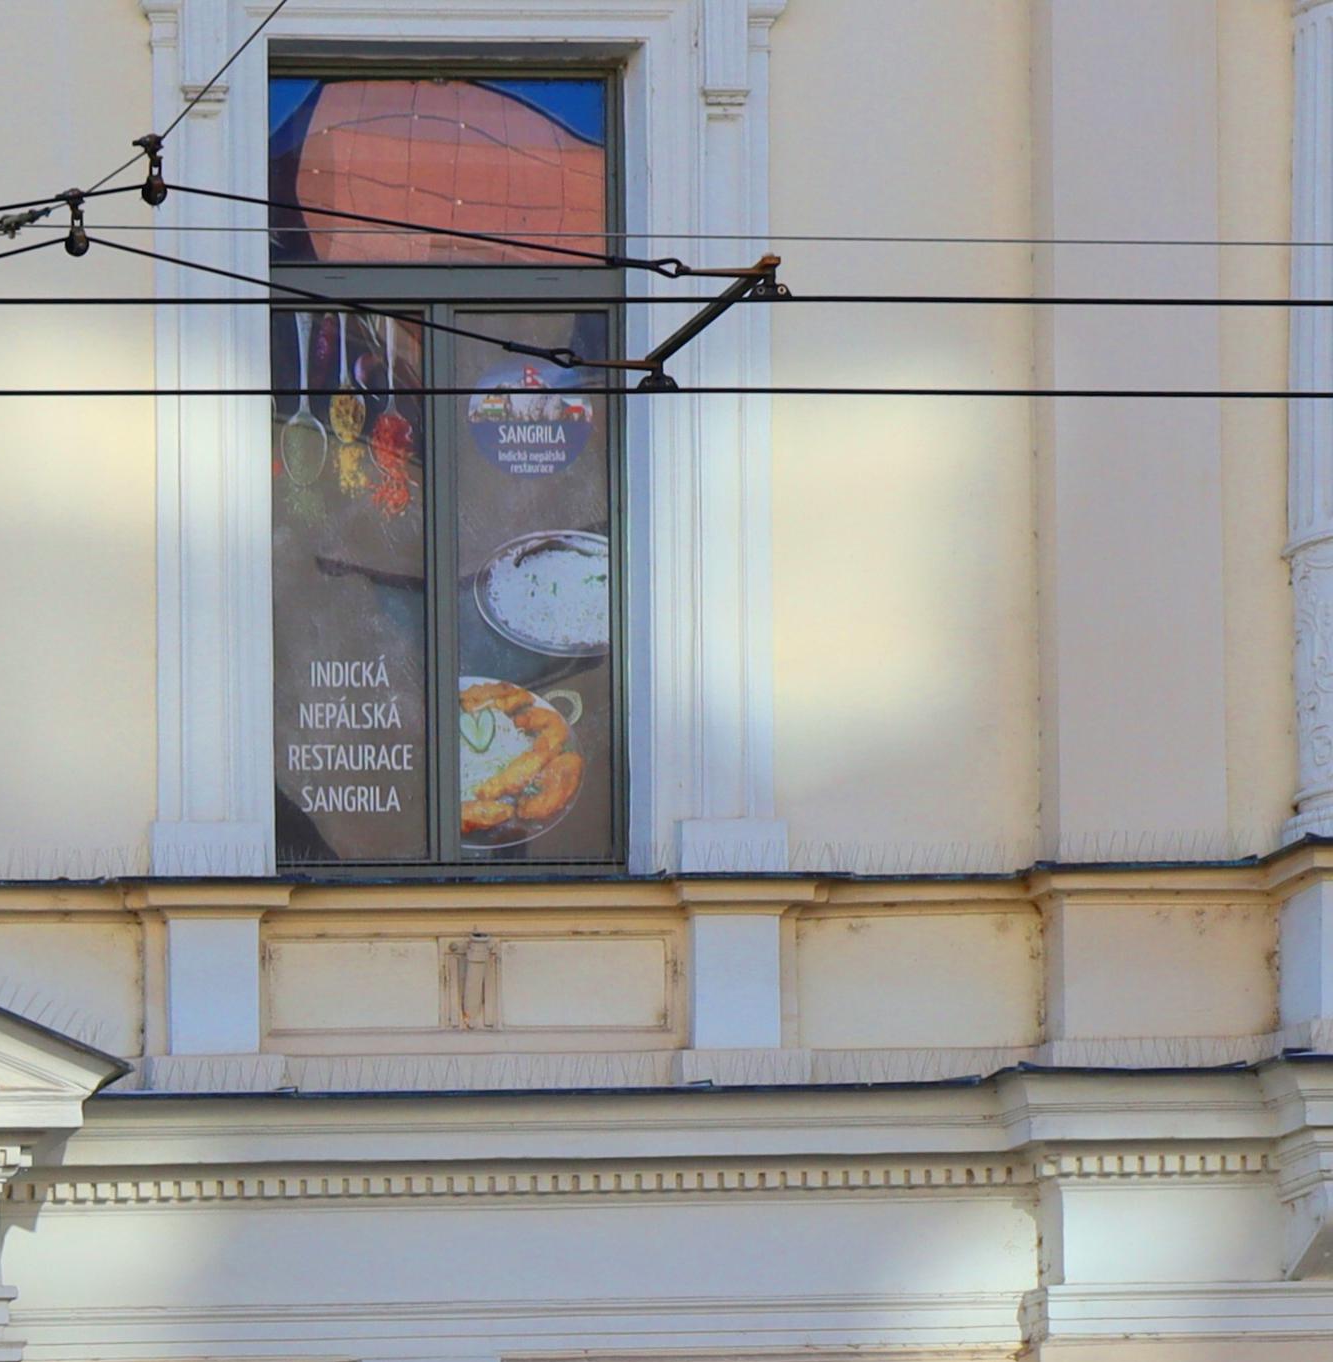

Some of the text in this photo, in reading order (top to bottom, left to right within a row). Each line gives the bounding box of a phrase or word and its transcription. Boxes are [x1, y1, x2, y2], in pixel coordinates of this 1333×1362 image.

[498, 425, 566, 444] SANGRILA
[310, 656, 389, 688] INDICKÁ
[299, 697, 401, 729] NEPÁLSKÁ
[289, 745, 413, 771] RESTAURACE
[302, 787, 401, 813] SANGRILA
